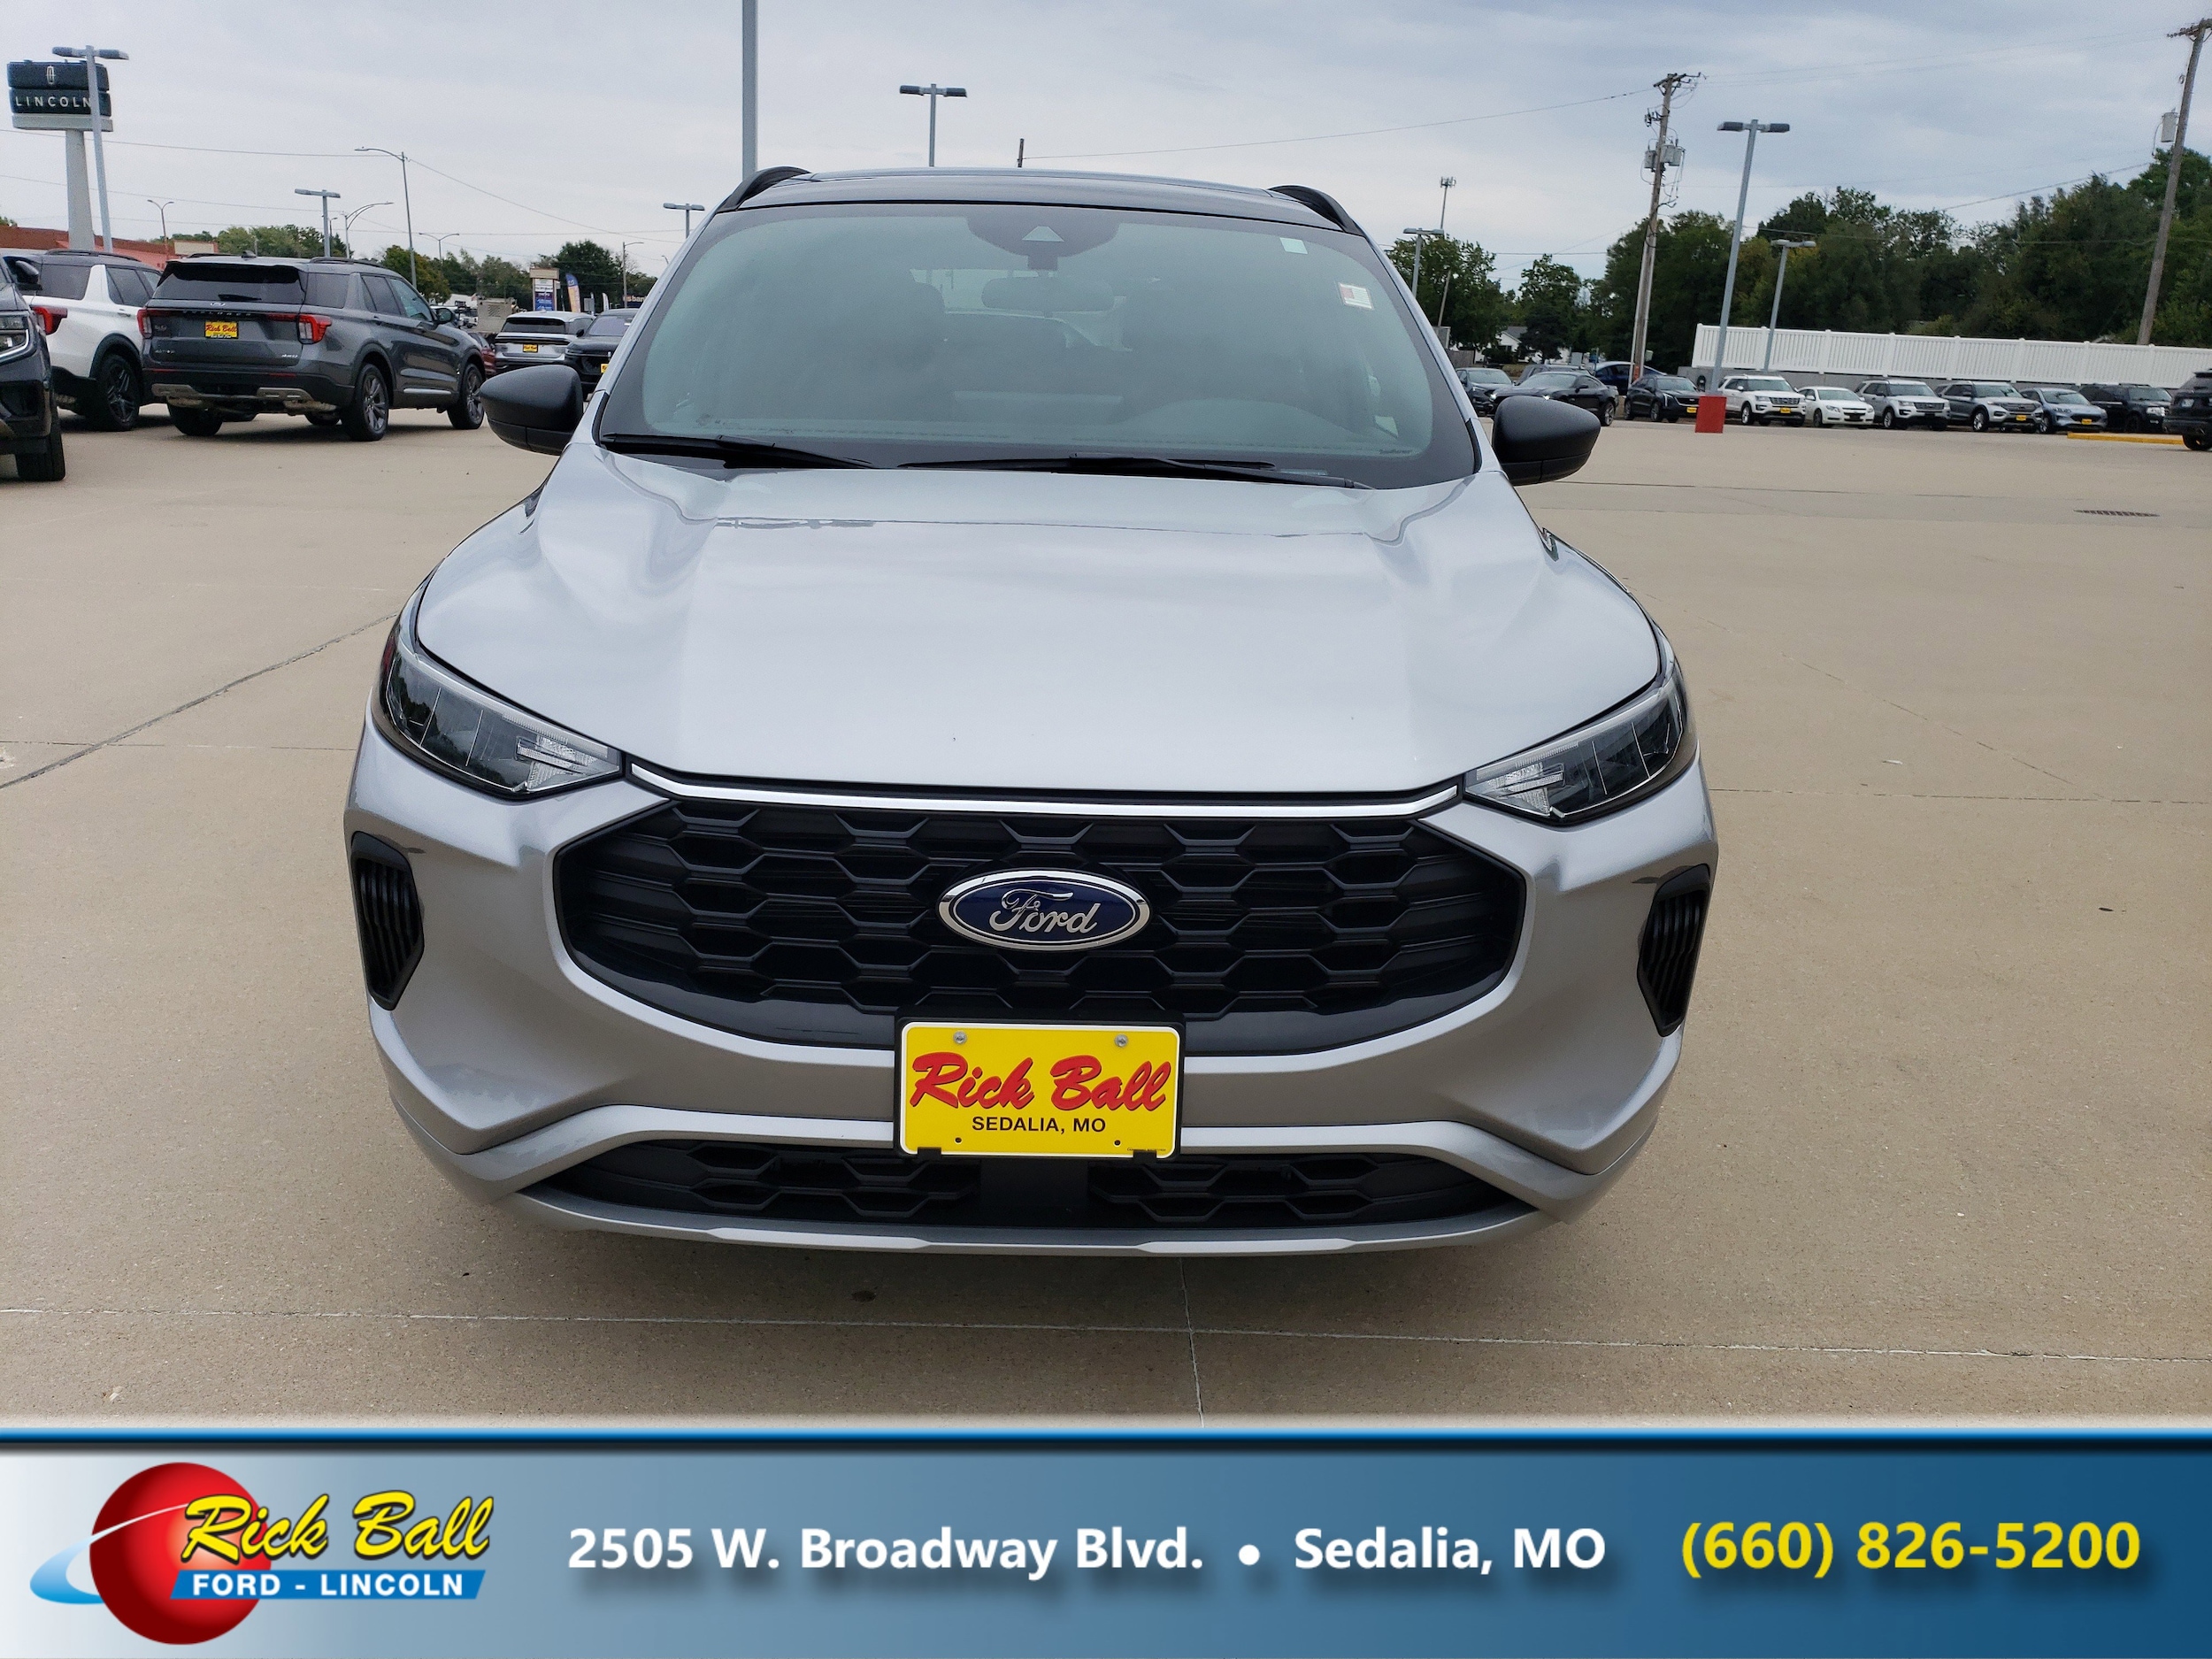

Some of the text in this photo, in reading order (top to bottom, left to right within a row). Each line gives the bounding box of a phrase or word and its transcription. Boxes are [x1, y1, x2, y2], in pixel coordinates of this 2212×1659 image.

[15, 96, 91, 107] LINCOLN
[988, 888, 1101, 933] Ford
[910, 1051, 1171, 1112] Rick Ball
[972, 1116, 1106, 1134] SEDALIA, MO
